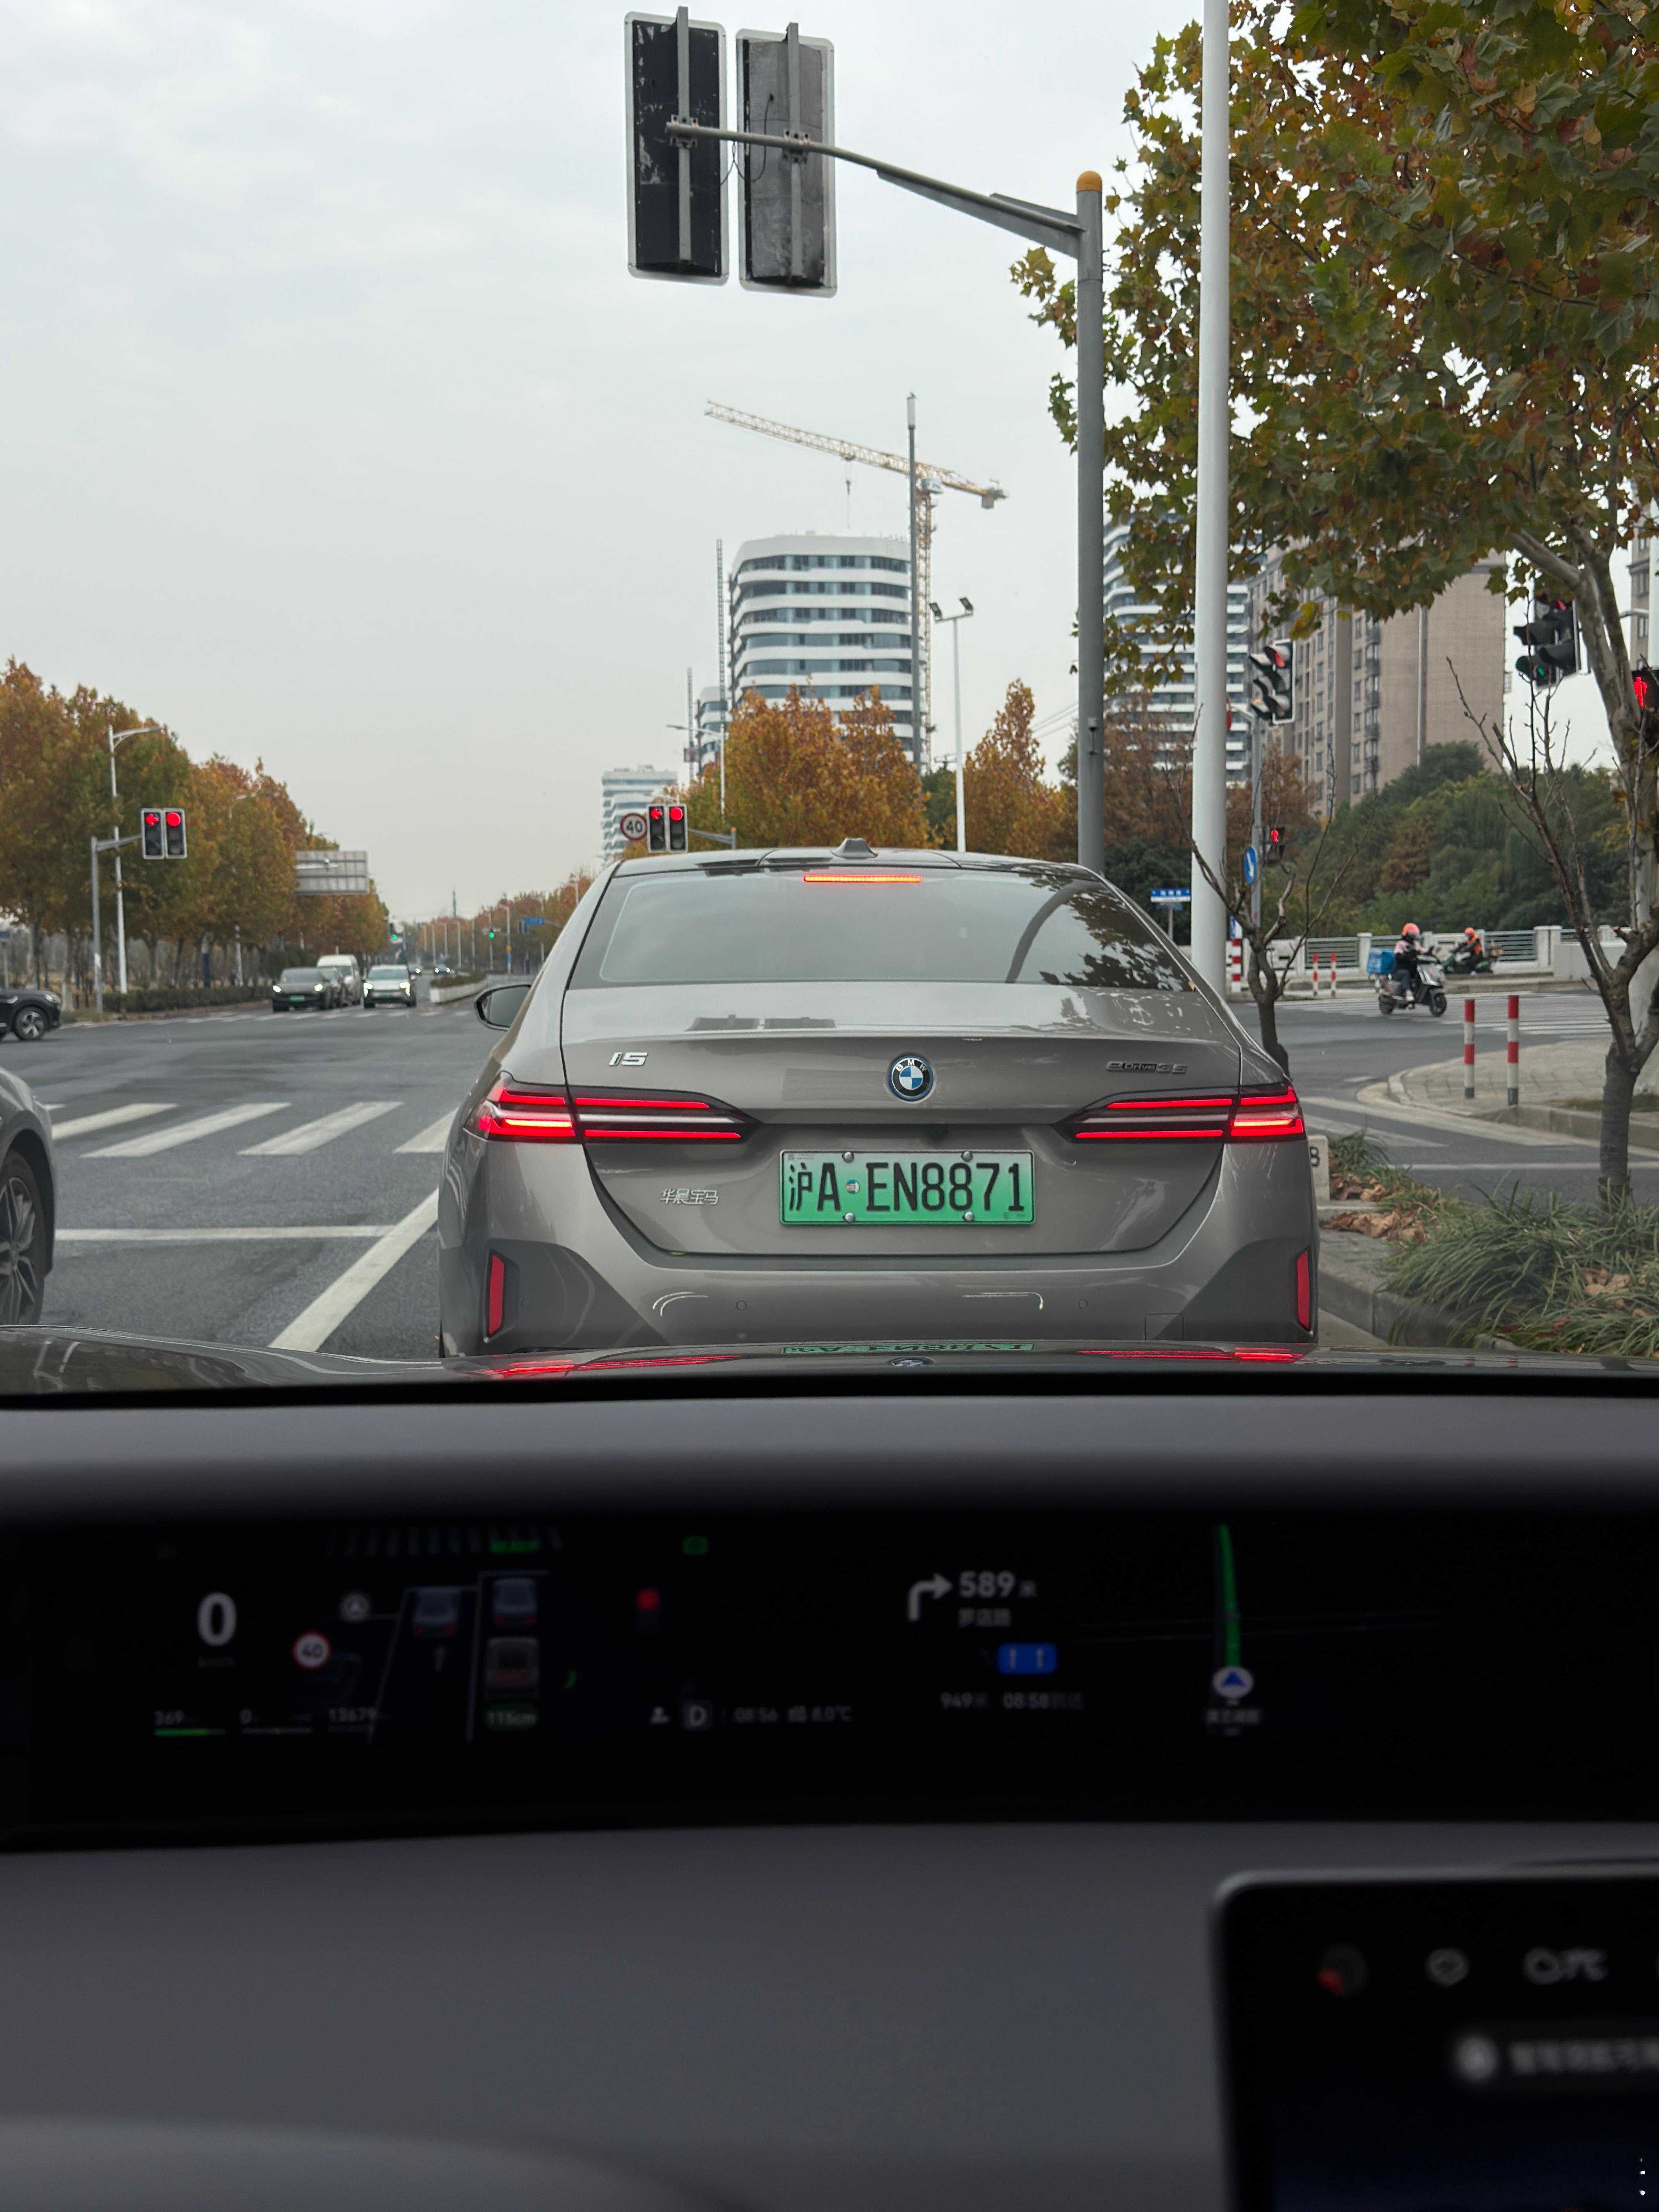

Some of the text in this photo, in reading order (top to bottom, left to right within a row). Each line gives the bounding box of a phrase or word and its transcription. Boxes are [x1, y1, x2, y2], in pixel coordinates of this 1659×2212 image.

[626, 820, 643, 833] 40
[609, 1052, 648, 1066] i5
[895, 1059, 927, 1072] BMW
[789, 1162, 1025, 1212] 沪A EN8871
[660, 1188, 719, 1205] 华晨宝马
[960, 1571, 1015, 1598] 589
[197, 1592, 236, 1646] 0
[302, 1644, 323, 1660] 40
[688, 1705, 707, 1727] D
